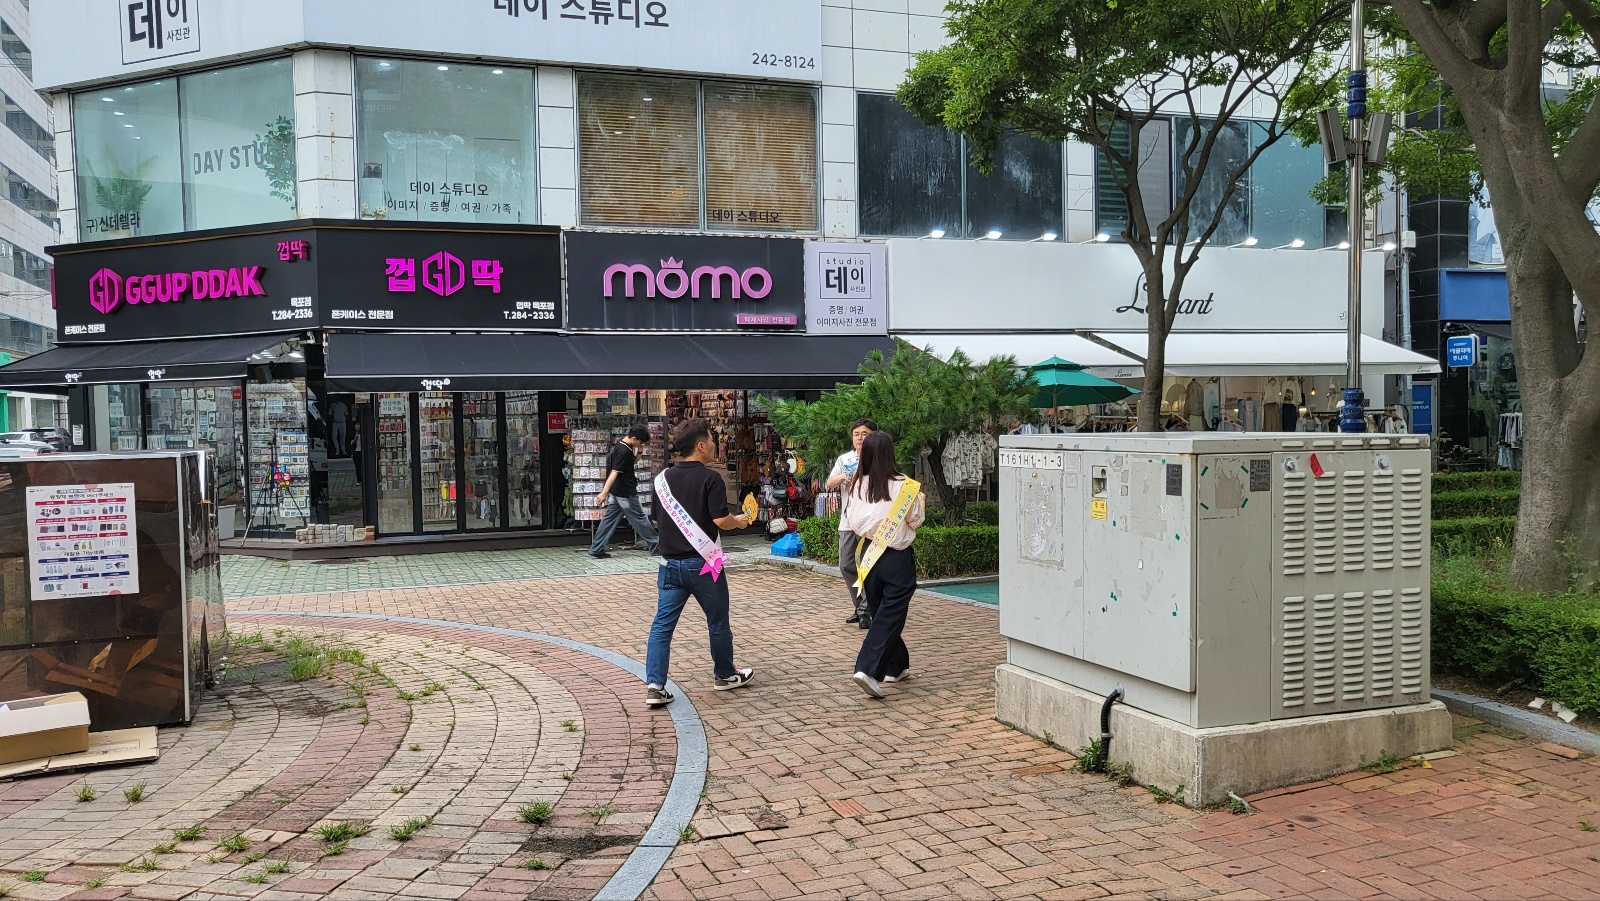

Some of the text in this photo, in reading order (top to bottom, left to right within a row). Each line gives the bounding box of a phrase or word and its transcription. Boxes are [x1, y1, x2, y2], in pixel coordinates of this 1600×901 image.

[560, 0, 670, 28] 스튜디오
[167, 27, 190, 42] 사진관
[752, 52, 815, 69] 242-8124
[193, 148, 224, 175] DAY
[410, 181, 489, 196] 데이 스튜디오
[387, 199, 418, 211] 이미지
[430, 201, 450, 212] 증명
[461, 202, 481, 213] 여권
[492, 202, 512, 214] 가족
[712, 209, 780, 223] 데이 스튜디오
[277, 240, 305, 260] 껍딱
[826, 257, 864, 265] studio
[125, 272, 189, 305] GGUP
[192, 266, 265, 300] DDAK
[603, 262, 773, 299] momo
[825, 267, 863, 294] 데이
[516, 301, 531, 310] 껍딱
[829, 306, 843, 314] 증명
[850, 306, 864, 314] 여권
[271, 308, 313, 320] T.284-2336
[331, 310, 394, 319] 폰케이스 전문점
[503, 311, 555, 320] T.284-2336
[816, 317, 877, 327] 이미지사진 전문점
